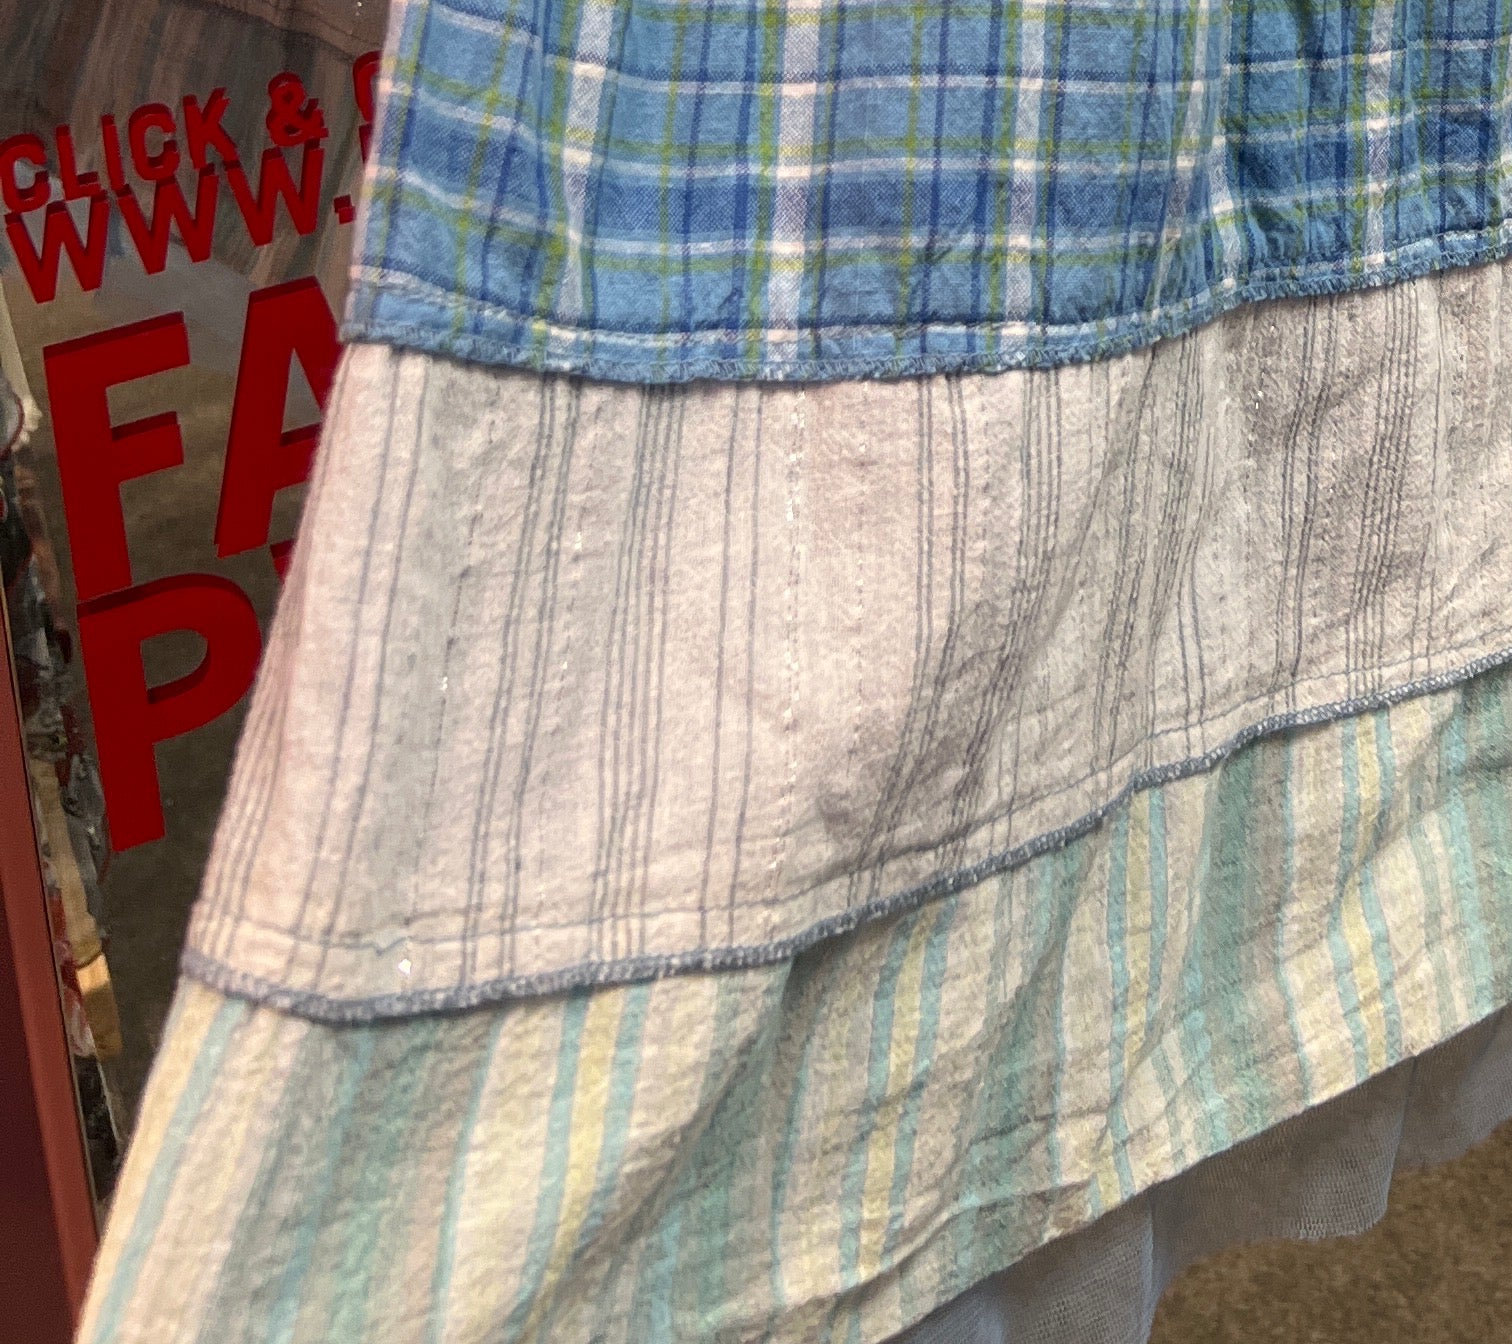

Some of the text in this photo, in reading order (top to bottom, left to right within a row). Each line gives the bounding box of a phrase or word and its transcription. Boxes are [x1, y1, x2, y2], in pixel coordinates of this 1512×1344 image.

[0, 86, 231, 213] CLICK
[265, 70, 329, 148] &
[5, 136, 358, 305] WWW.
